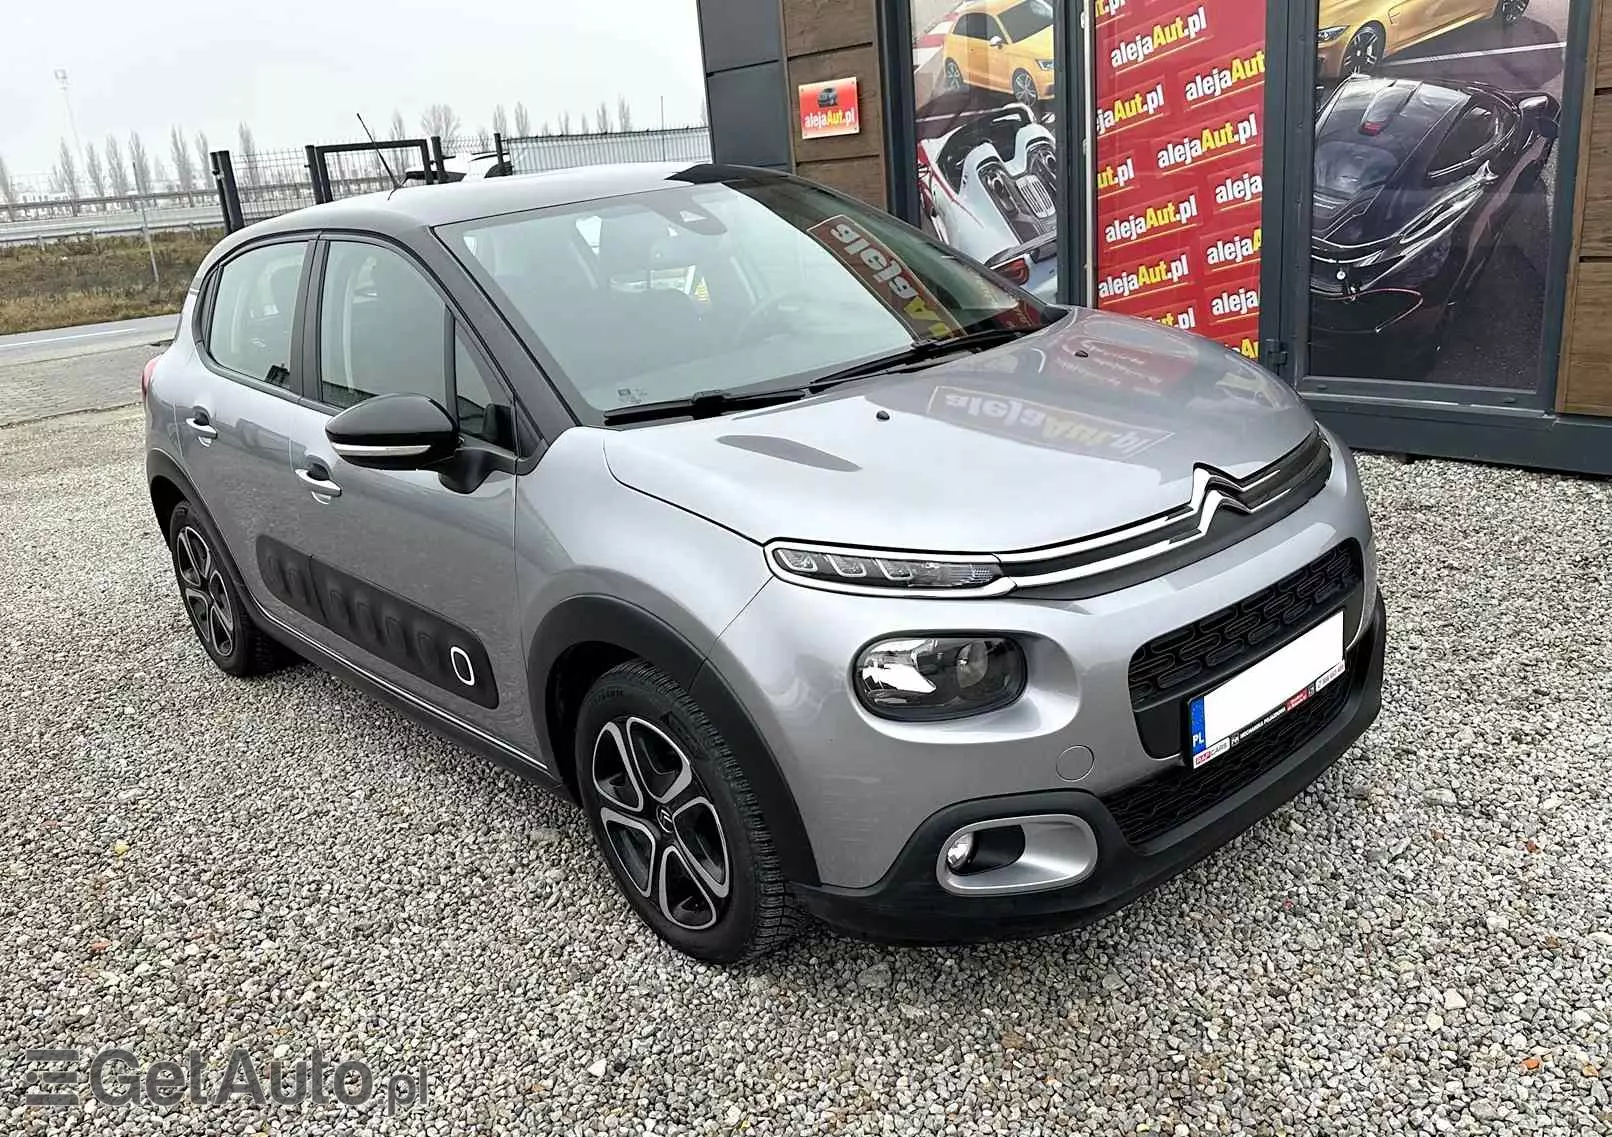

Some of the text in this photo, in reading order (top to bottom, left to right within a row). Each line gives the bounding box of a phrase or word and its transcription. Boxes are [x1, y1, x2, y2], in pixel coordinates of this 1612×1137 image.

[1110, 6, 1207, 68] alejaAut.pl
[804, 107, 856, 128] alejaAut.pl
[1096, 84, 1165, 135] jaAut.pl
[1157, 112, 1258, 169] alejaAut.pl
[1215, 173, 1263, 204] aleja
[1104, 194, 1198, 243] alejaAut.pl
[1098, 254, 1189, 298] alejaAut.pl
[1211, 288, 1259, 316] aleja
[1192, 732, 1205, 748] PL
